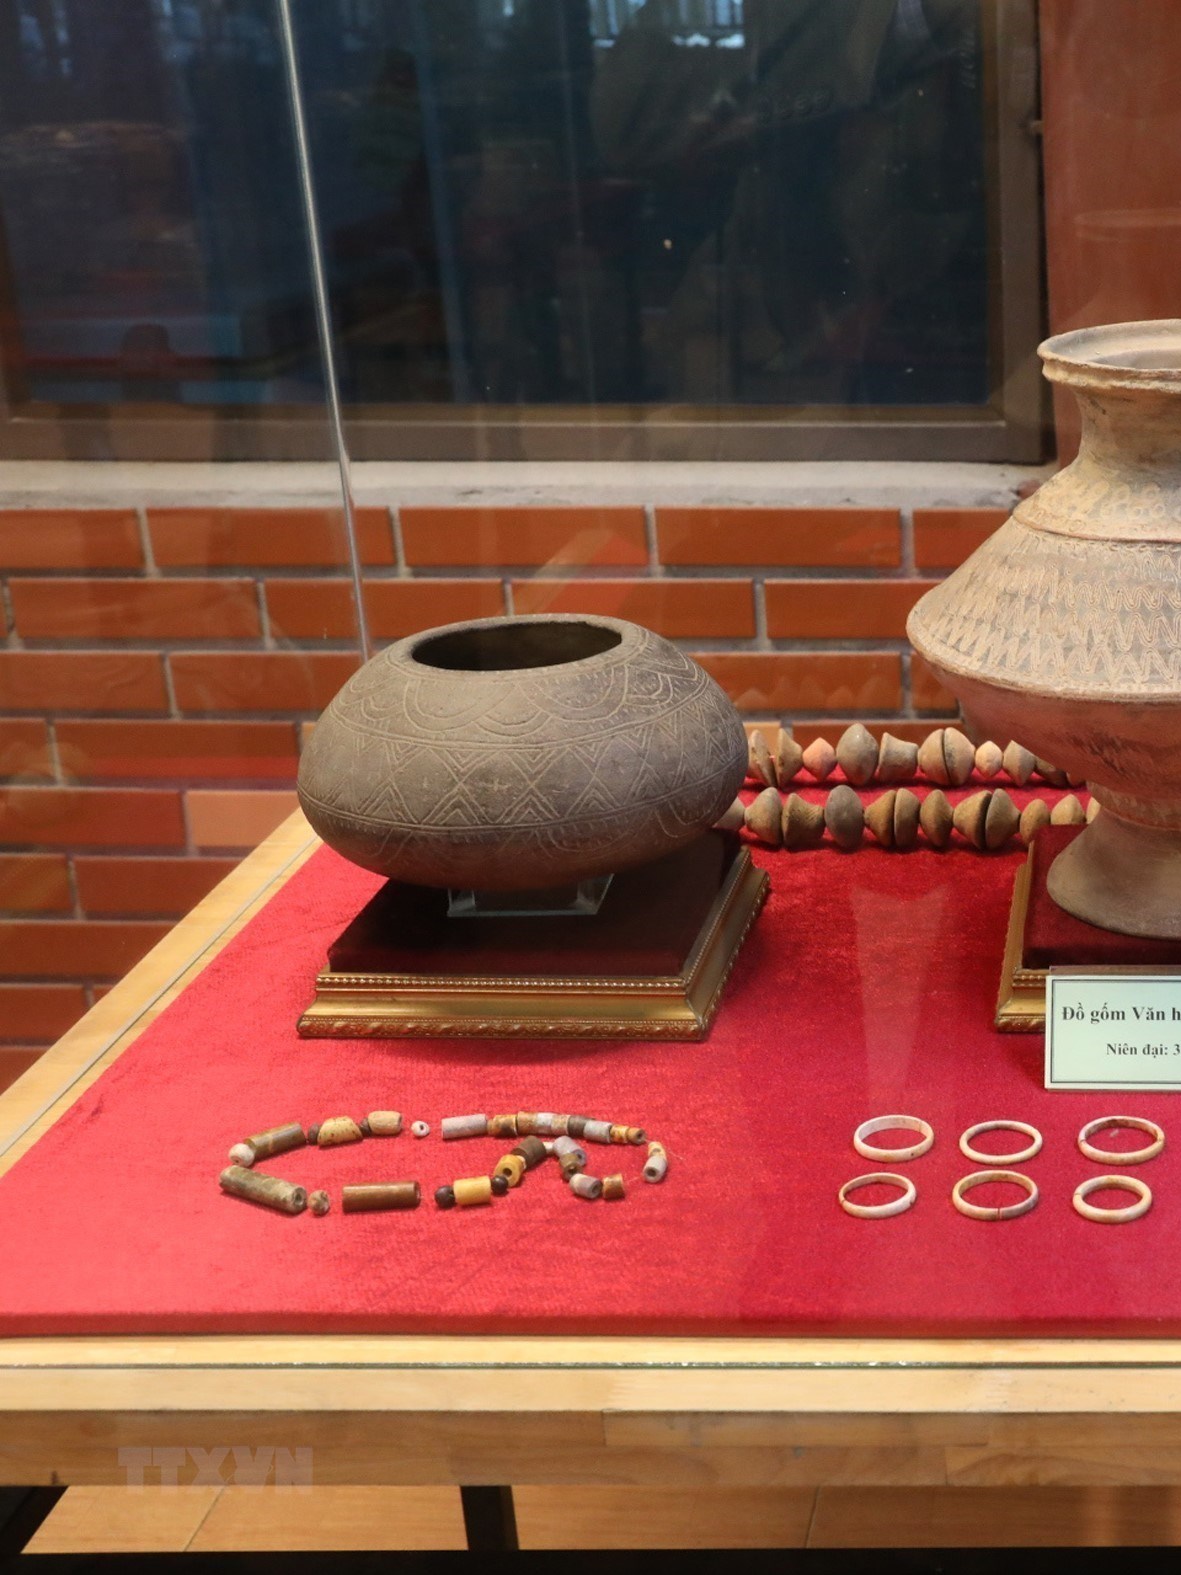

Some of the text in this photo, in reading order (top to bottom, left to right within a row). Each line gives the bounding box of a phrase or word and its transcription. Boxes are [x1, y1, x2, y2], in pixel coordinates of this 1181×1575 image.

[1061, 1001, 1085, 1022] Đồ
[1090, 1002, 1126, 1023] gốm
[1132, 1006, 1166, 1022] Văn
[1106, 1041, 1138, 1057] Niên
[1142, 1042, 1169, 1059] đại:
